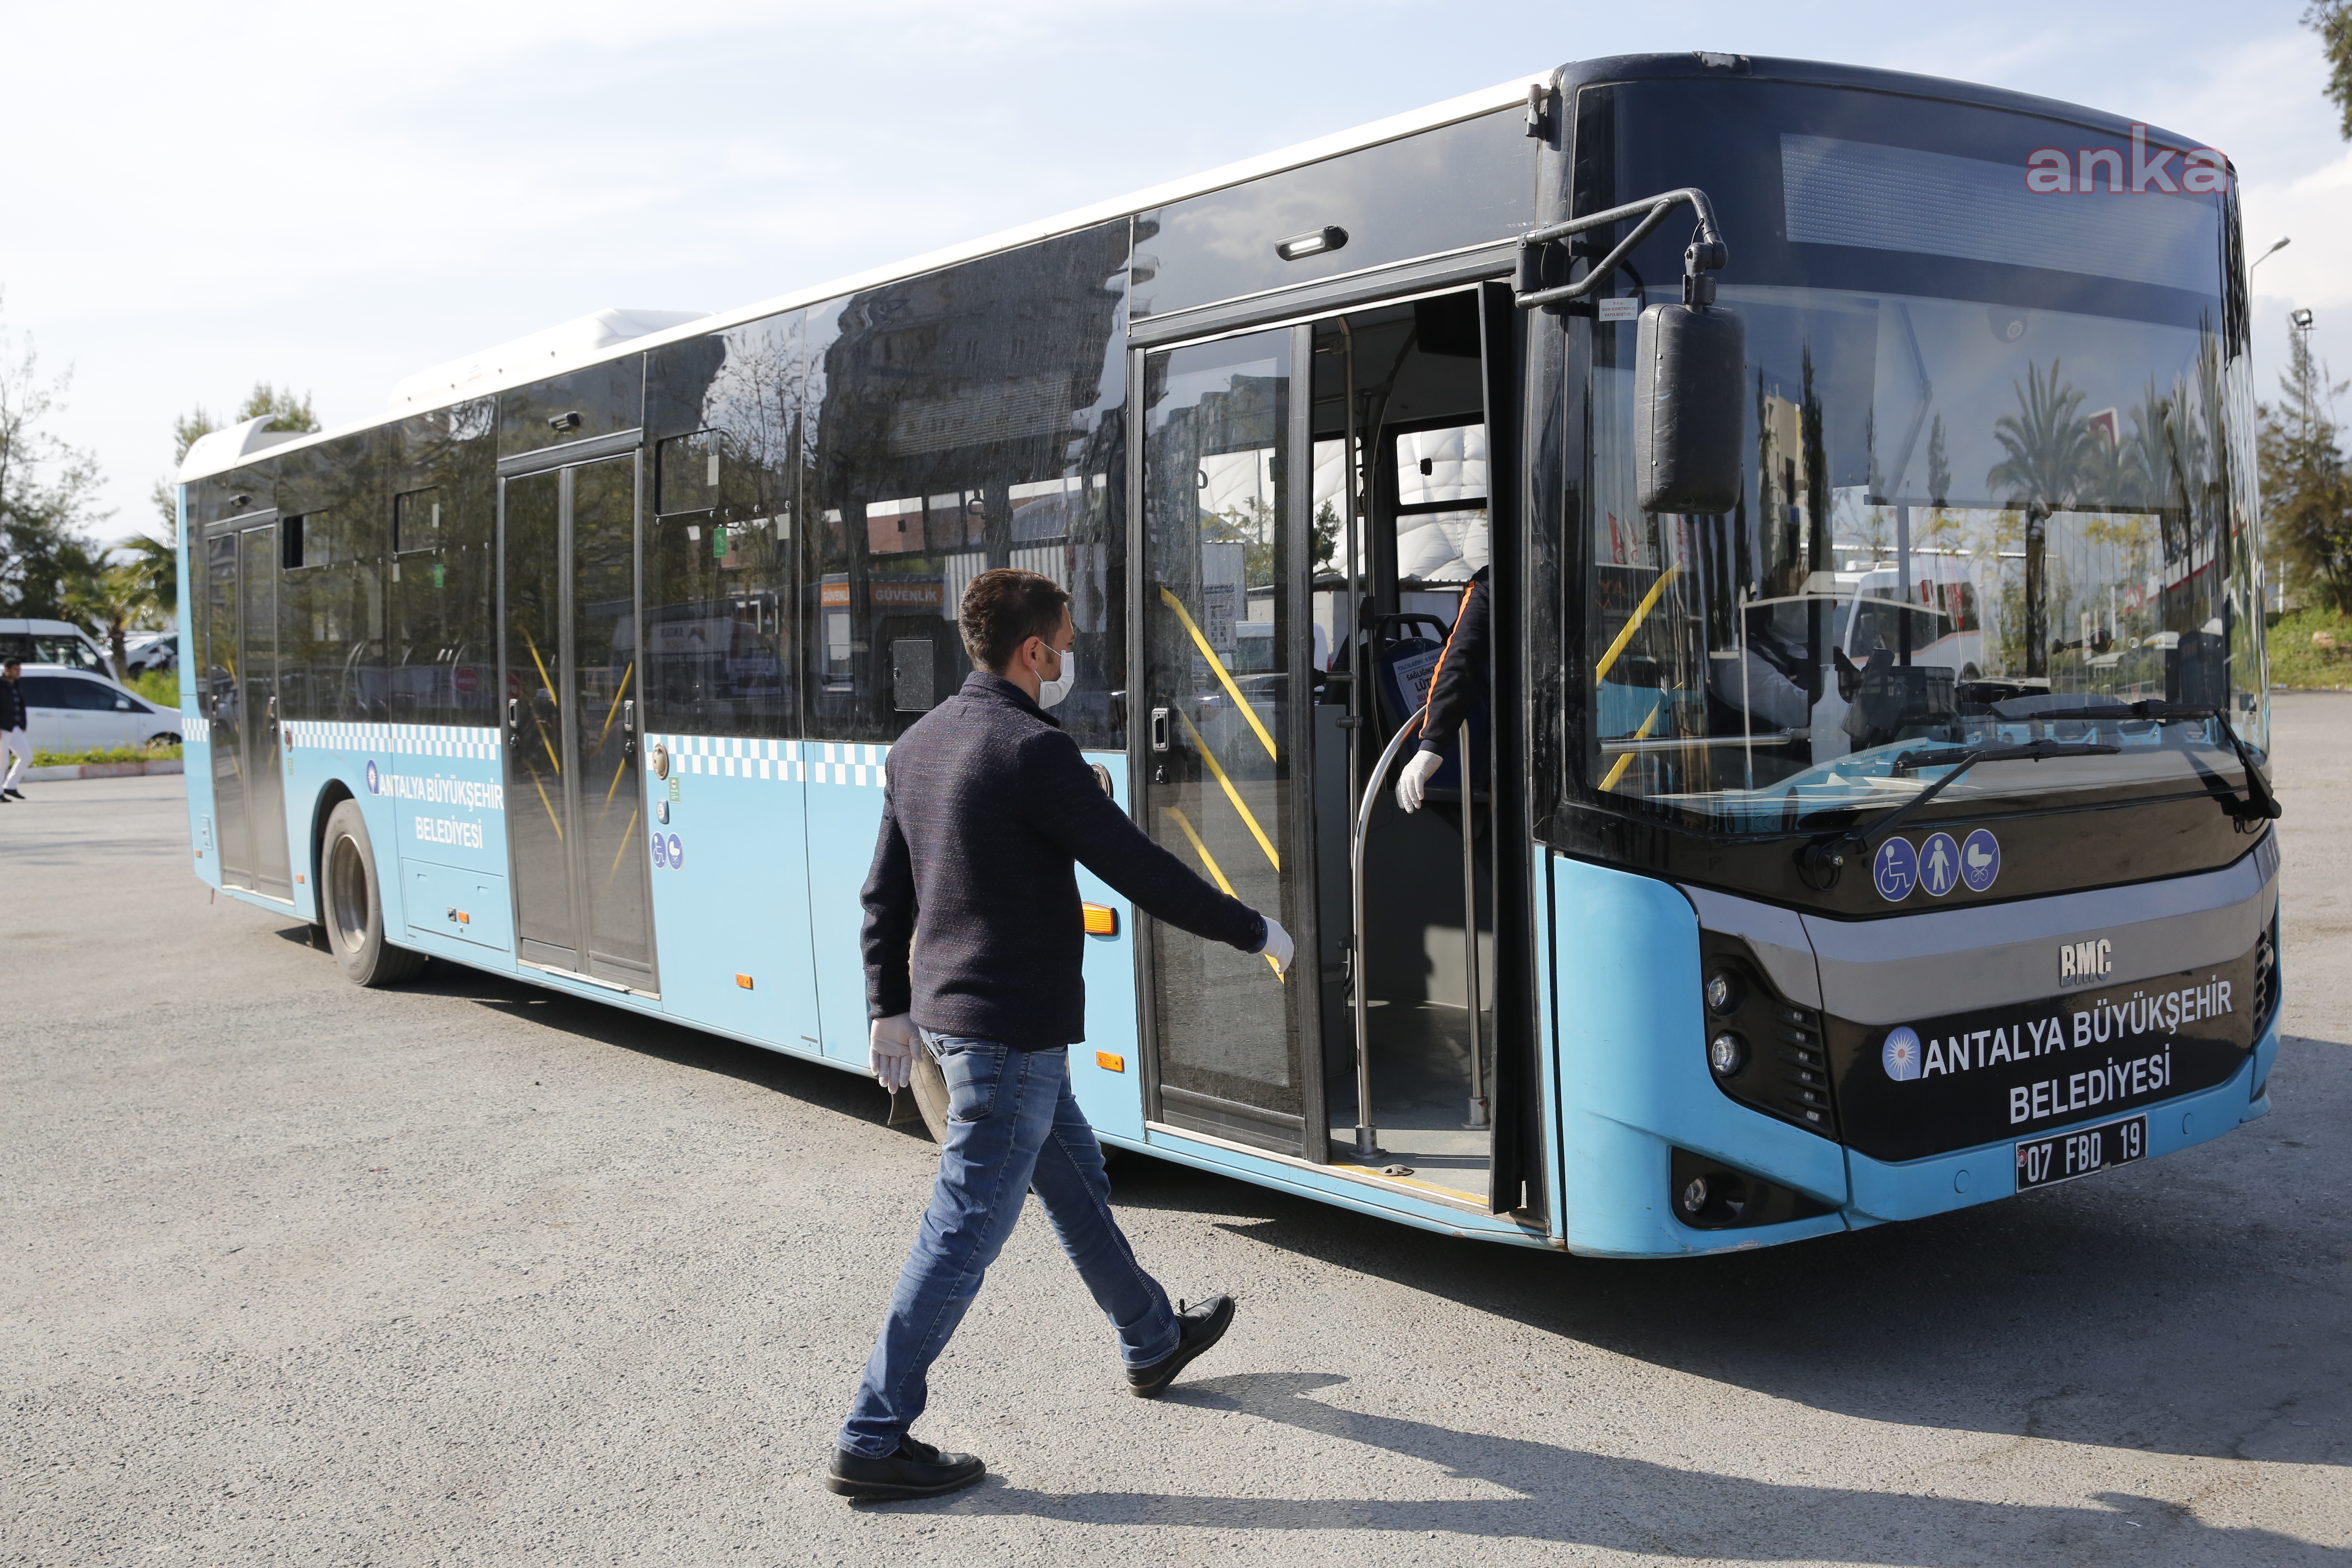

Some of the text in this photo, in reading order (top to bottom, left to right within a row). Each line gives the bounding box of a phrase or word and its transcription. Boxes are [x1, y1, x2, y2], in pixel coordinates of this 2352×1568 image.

[875, 588, 937, 601] GÜVENLİK
[379, 773, 505, 812] ANTALYA BÜYÜKŞEHİR
[415, 815, 483, 849] BELEDİYESİ
[2060, 938, 2112, 987] BMC
[1922, 975, 2232, 1078] ANTALYA BÜYÜKŞEHİR
[2010, 1043, 2170, 1124] BELEDİYESİ
[2027, 1122, 2140, 1182] 07 FBD 19
